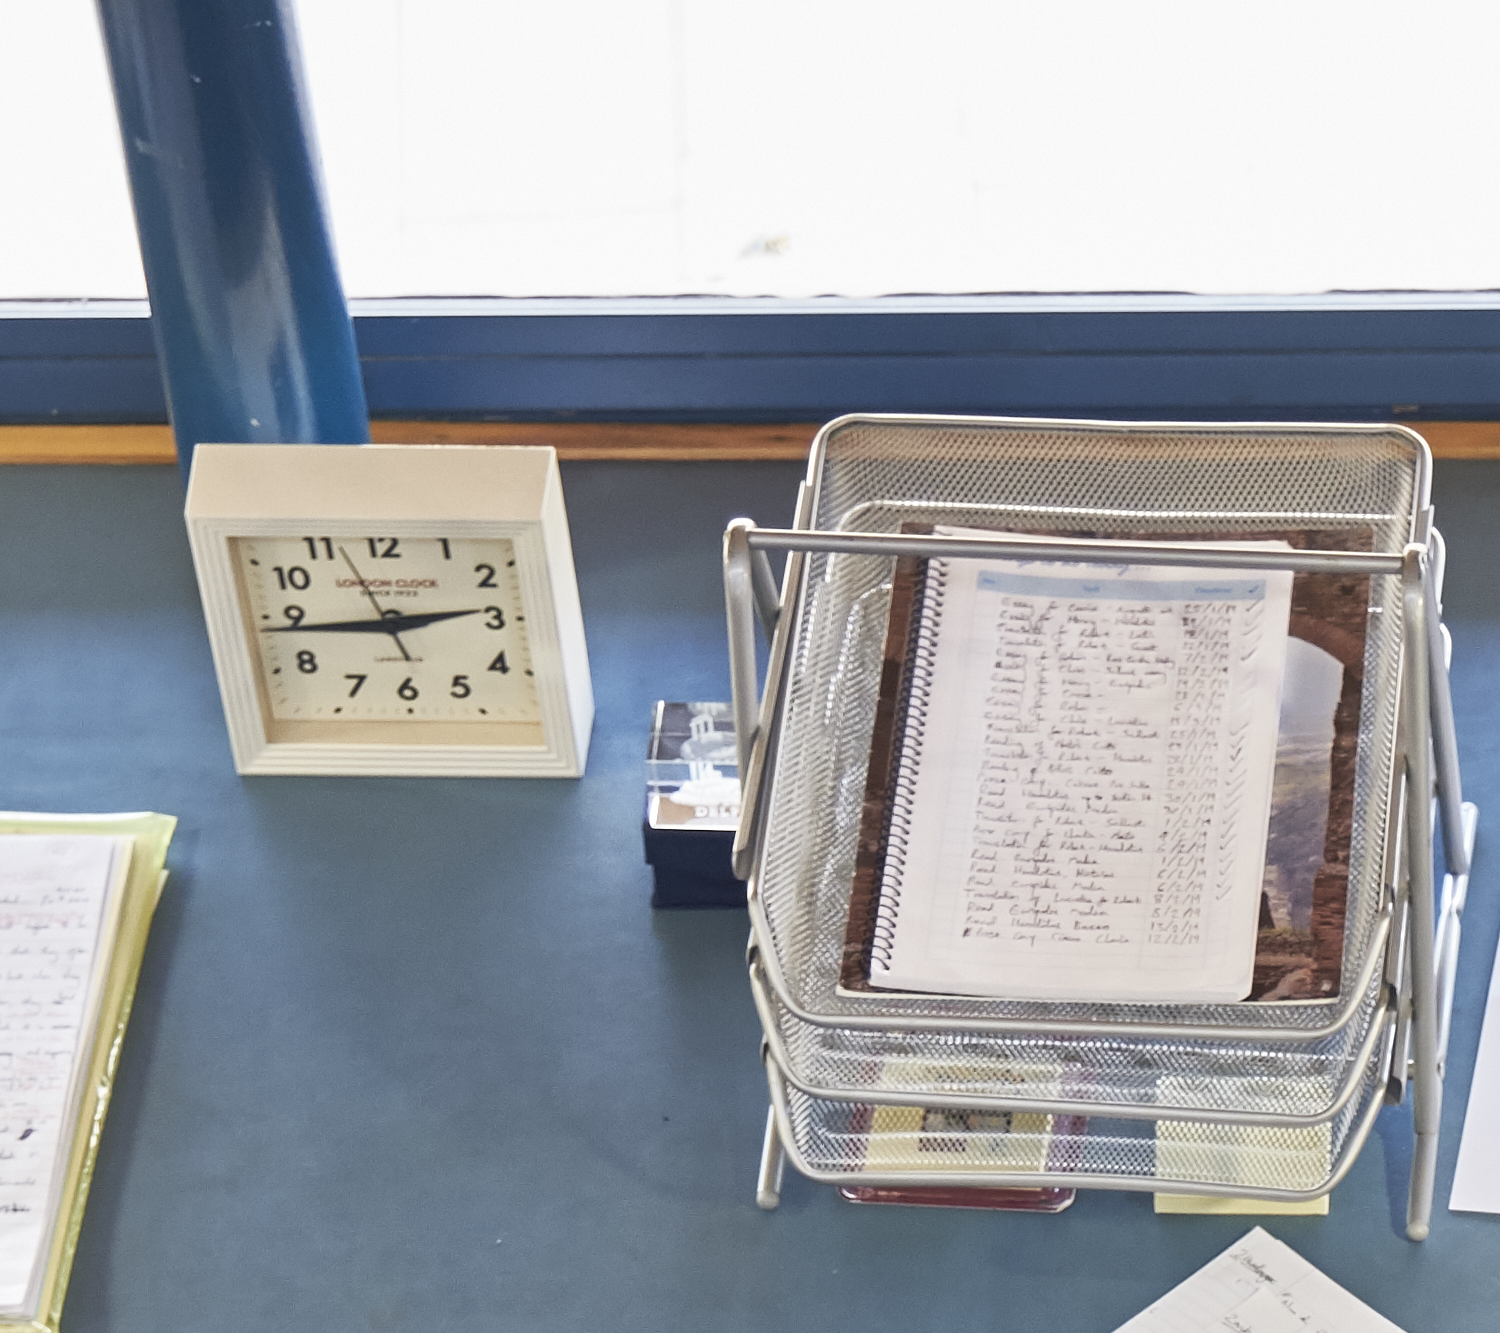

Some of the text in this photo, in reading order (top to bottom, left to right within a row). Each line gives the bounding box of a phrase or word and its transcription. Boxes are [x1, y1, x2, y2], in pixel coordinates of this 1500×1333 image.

[302, 537, 335, 561] 11
[366, 538, 400, 559] 12
[437, 539, 451, 560] 1
[273, 566, 311, 590] 10
[475, 565, 498, 589] 2
[283, 606, 305, 629] 9
[484, 607, 505, 630] 3
[297, 650, 318, 673] 8
[488, 651, 510, 674] 4
[344, 675, 368, 698] 7
[398, 677, 419, 701] 6
[450, 675, 472, 699] 5
